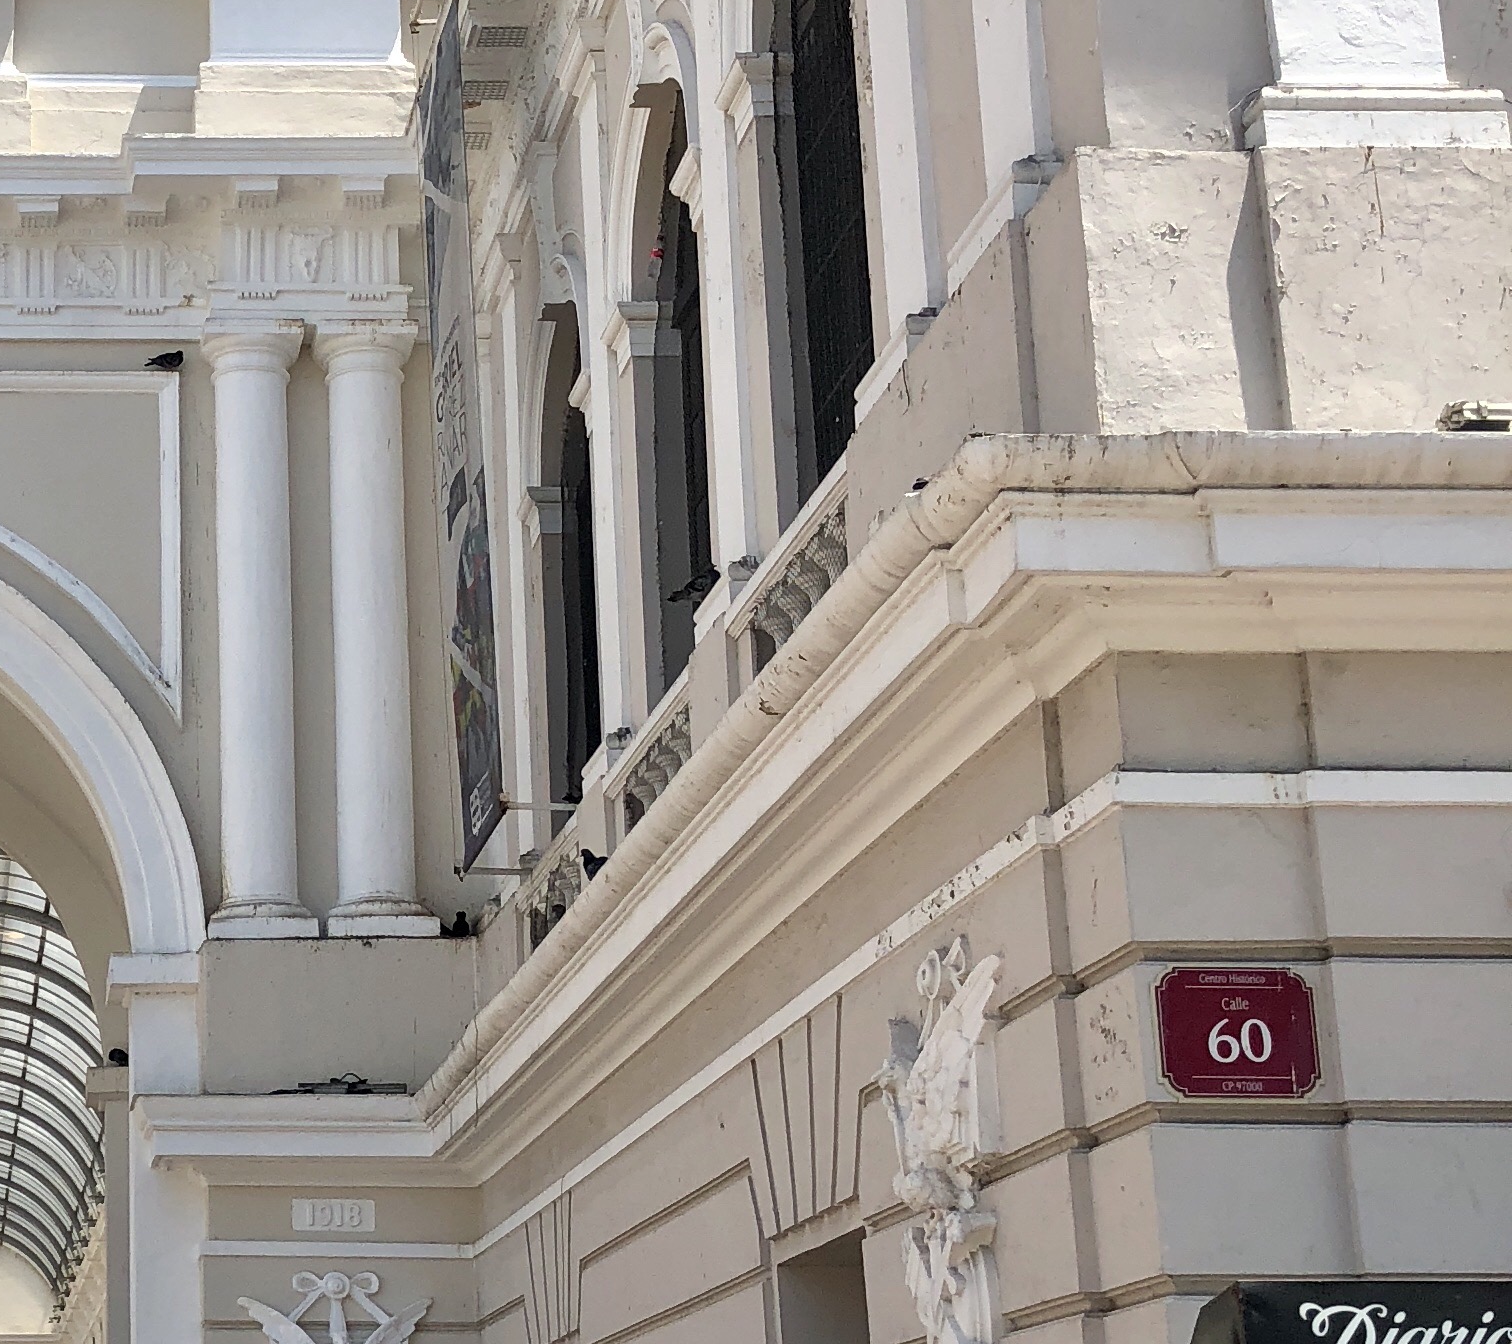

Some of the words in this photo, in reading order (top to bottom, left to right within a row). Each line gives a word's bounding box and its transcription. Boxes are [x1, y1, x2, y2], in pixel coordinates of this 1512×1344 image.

[1198, 974, 1227, 984] Centro
[1229, 974, 1266, 984] Histórico
[1221, 997, 1250, 1010] Calle
[1208, 1018, 1272, 1063] 60
[1222, 1082, 1234, 1091] CP
[306, 1203, 361, 1227] 1918
